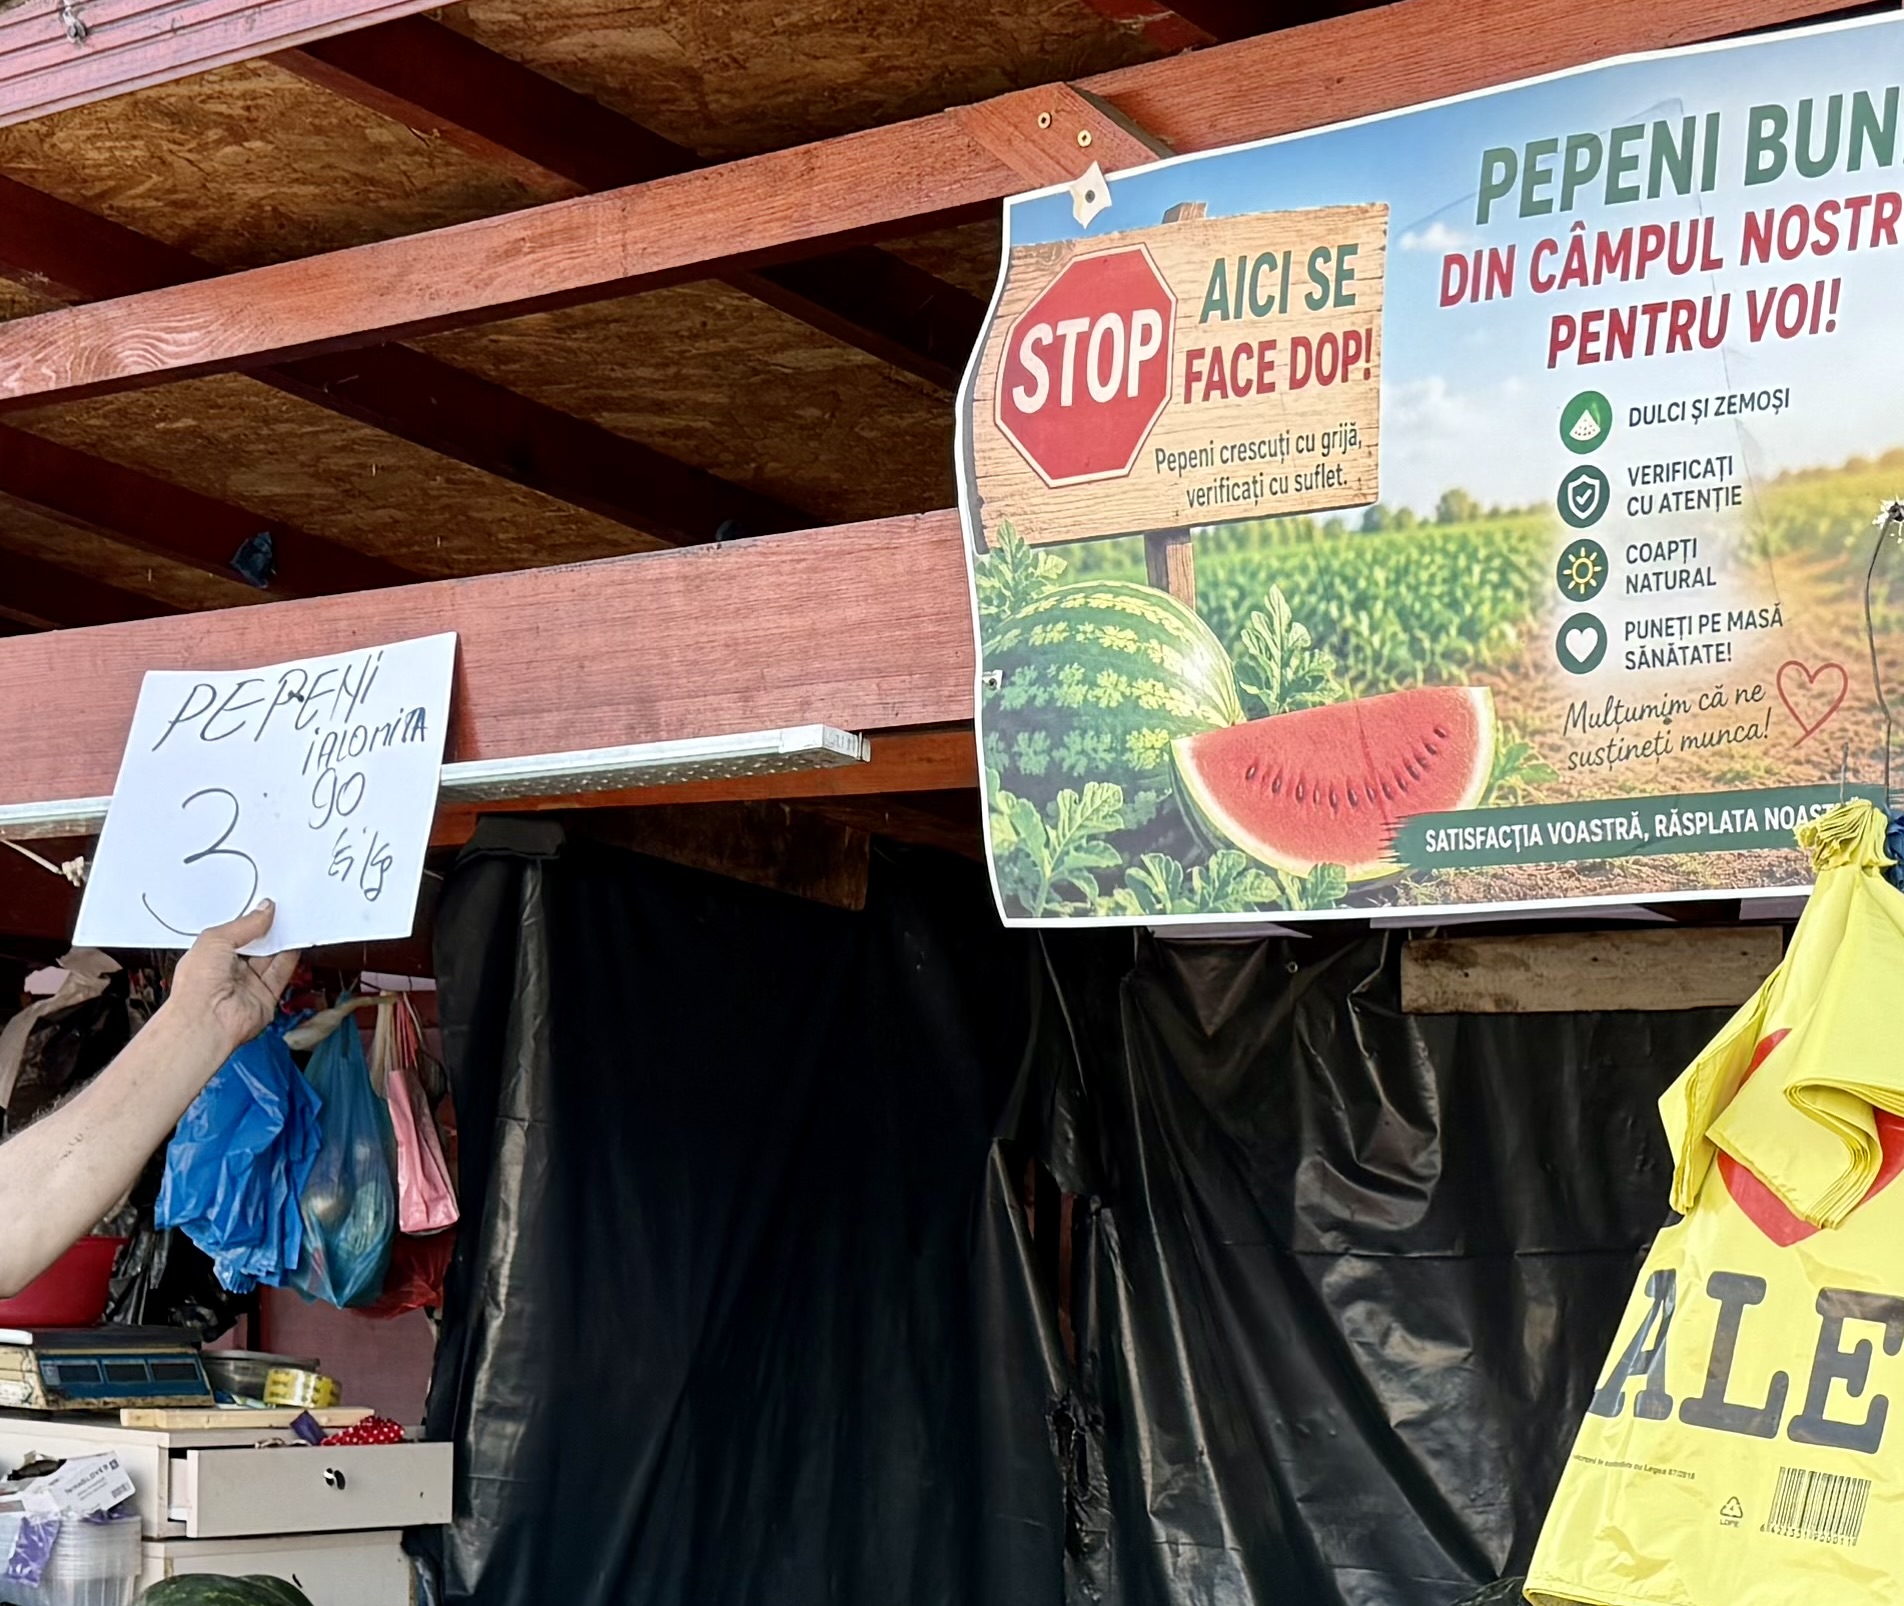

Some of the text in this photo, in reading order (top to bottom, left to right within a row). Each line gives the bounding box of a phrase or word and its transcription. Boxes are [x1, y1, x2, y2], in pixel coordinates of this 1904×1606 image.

[1476, 111, 1720, 226] PEPENI
[1199, 243, 1359, 325] AICI SE
[1439, 244, 1515, 308] DIN
[1529, 216, 1723, 294] CÂMPUL
[1547, 277, 1841, 369] PENTRU VOI!
[1011, 308, 1163, 414] STOP
[1183, 327, 1373, 404] FACE DOP!
[1628, 387, 1790, 427] DULCI ȘI ZEMOȘI
[1154, 422, 1362, 478] Pepeni crescuți cu grijă,
[1628, 455, 1733, 487] VERIFICAȚI
[1186, 464, 1347, 509] verificați cu suflet.
[1627, 485, 1742, 517] CU ATENȚIE
[1625, 537, 1697, 565] COAPȚI
[1625, 566, 1716, 594] NATURAL
[1624, 603, 1783, 642] PUNEȚI PE MASĂ
[1624, 642, 1732, 671] SĂNĂTATE!
[1563, 681, 1766, 736] Mulțumim că ne
[1567, 707, 1772, 771] susțineți munca!
[1424, 822, 1543, 853] SATISFACȚIA
[1547, 810, 1650, 845] VOASTRĂ,
[1655, 807, 1756, 839] RĂSPLATA
